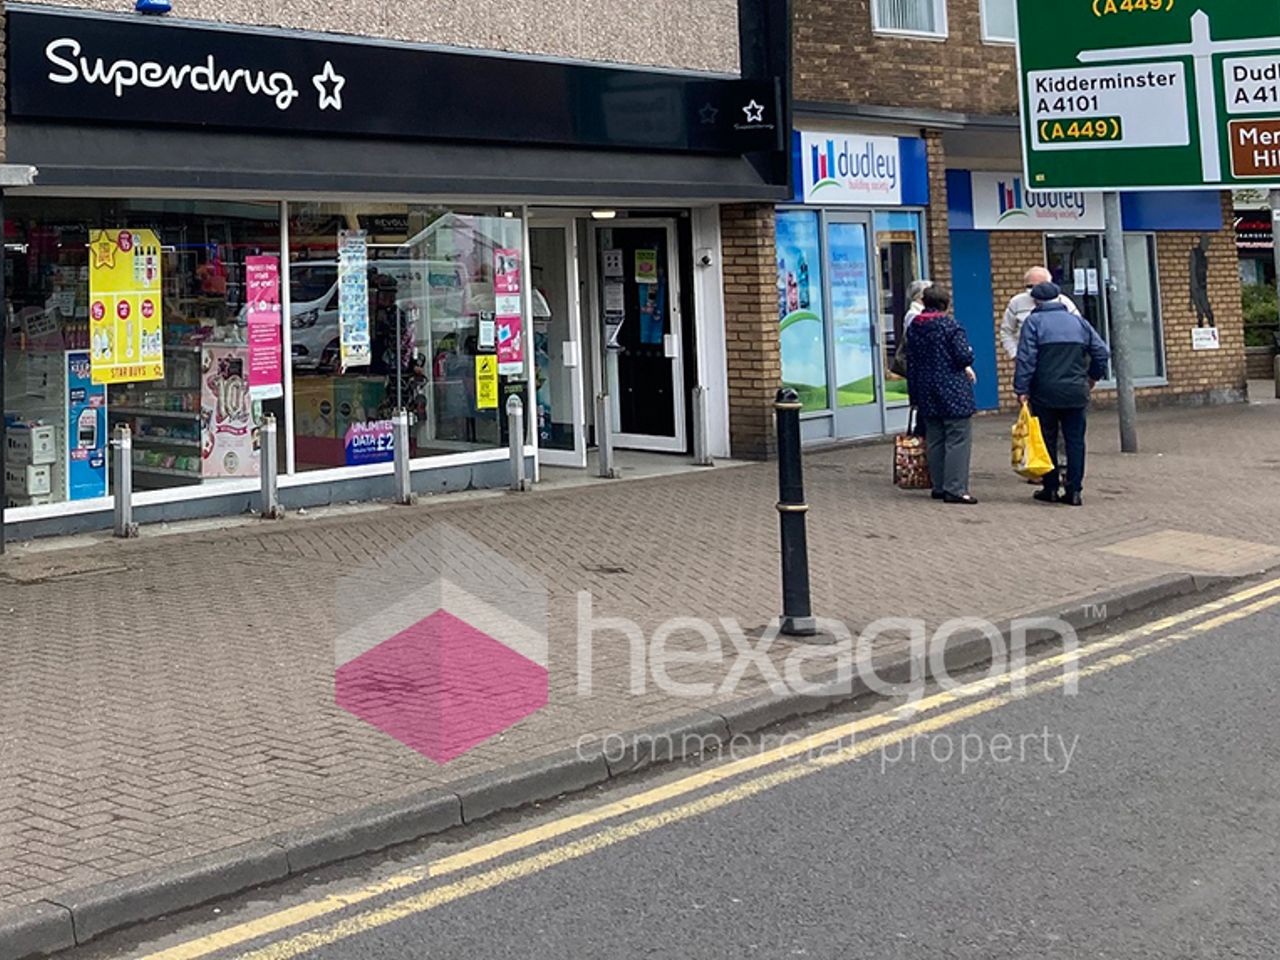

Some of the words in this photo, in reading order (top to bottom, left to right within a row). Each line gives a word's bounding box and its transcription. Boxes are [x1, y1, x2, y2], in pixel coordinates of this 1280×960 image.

[45, 37, 299, 110] Superdrug
[1035, 71, 1177, 94] Kidderminster
[1036, 95, 1098, 114] A4101
[1040, 118, 1120, 141] (A449)
[838, 140, 897, 189] dudley
[352, 433, 376, 448] DATA
